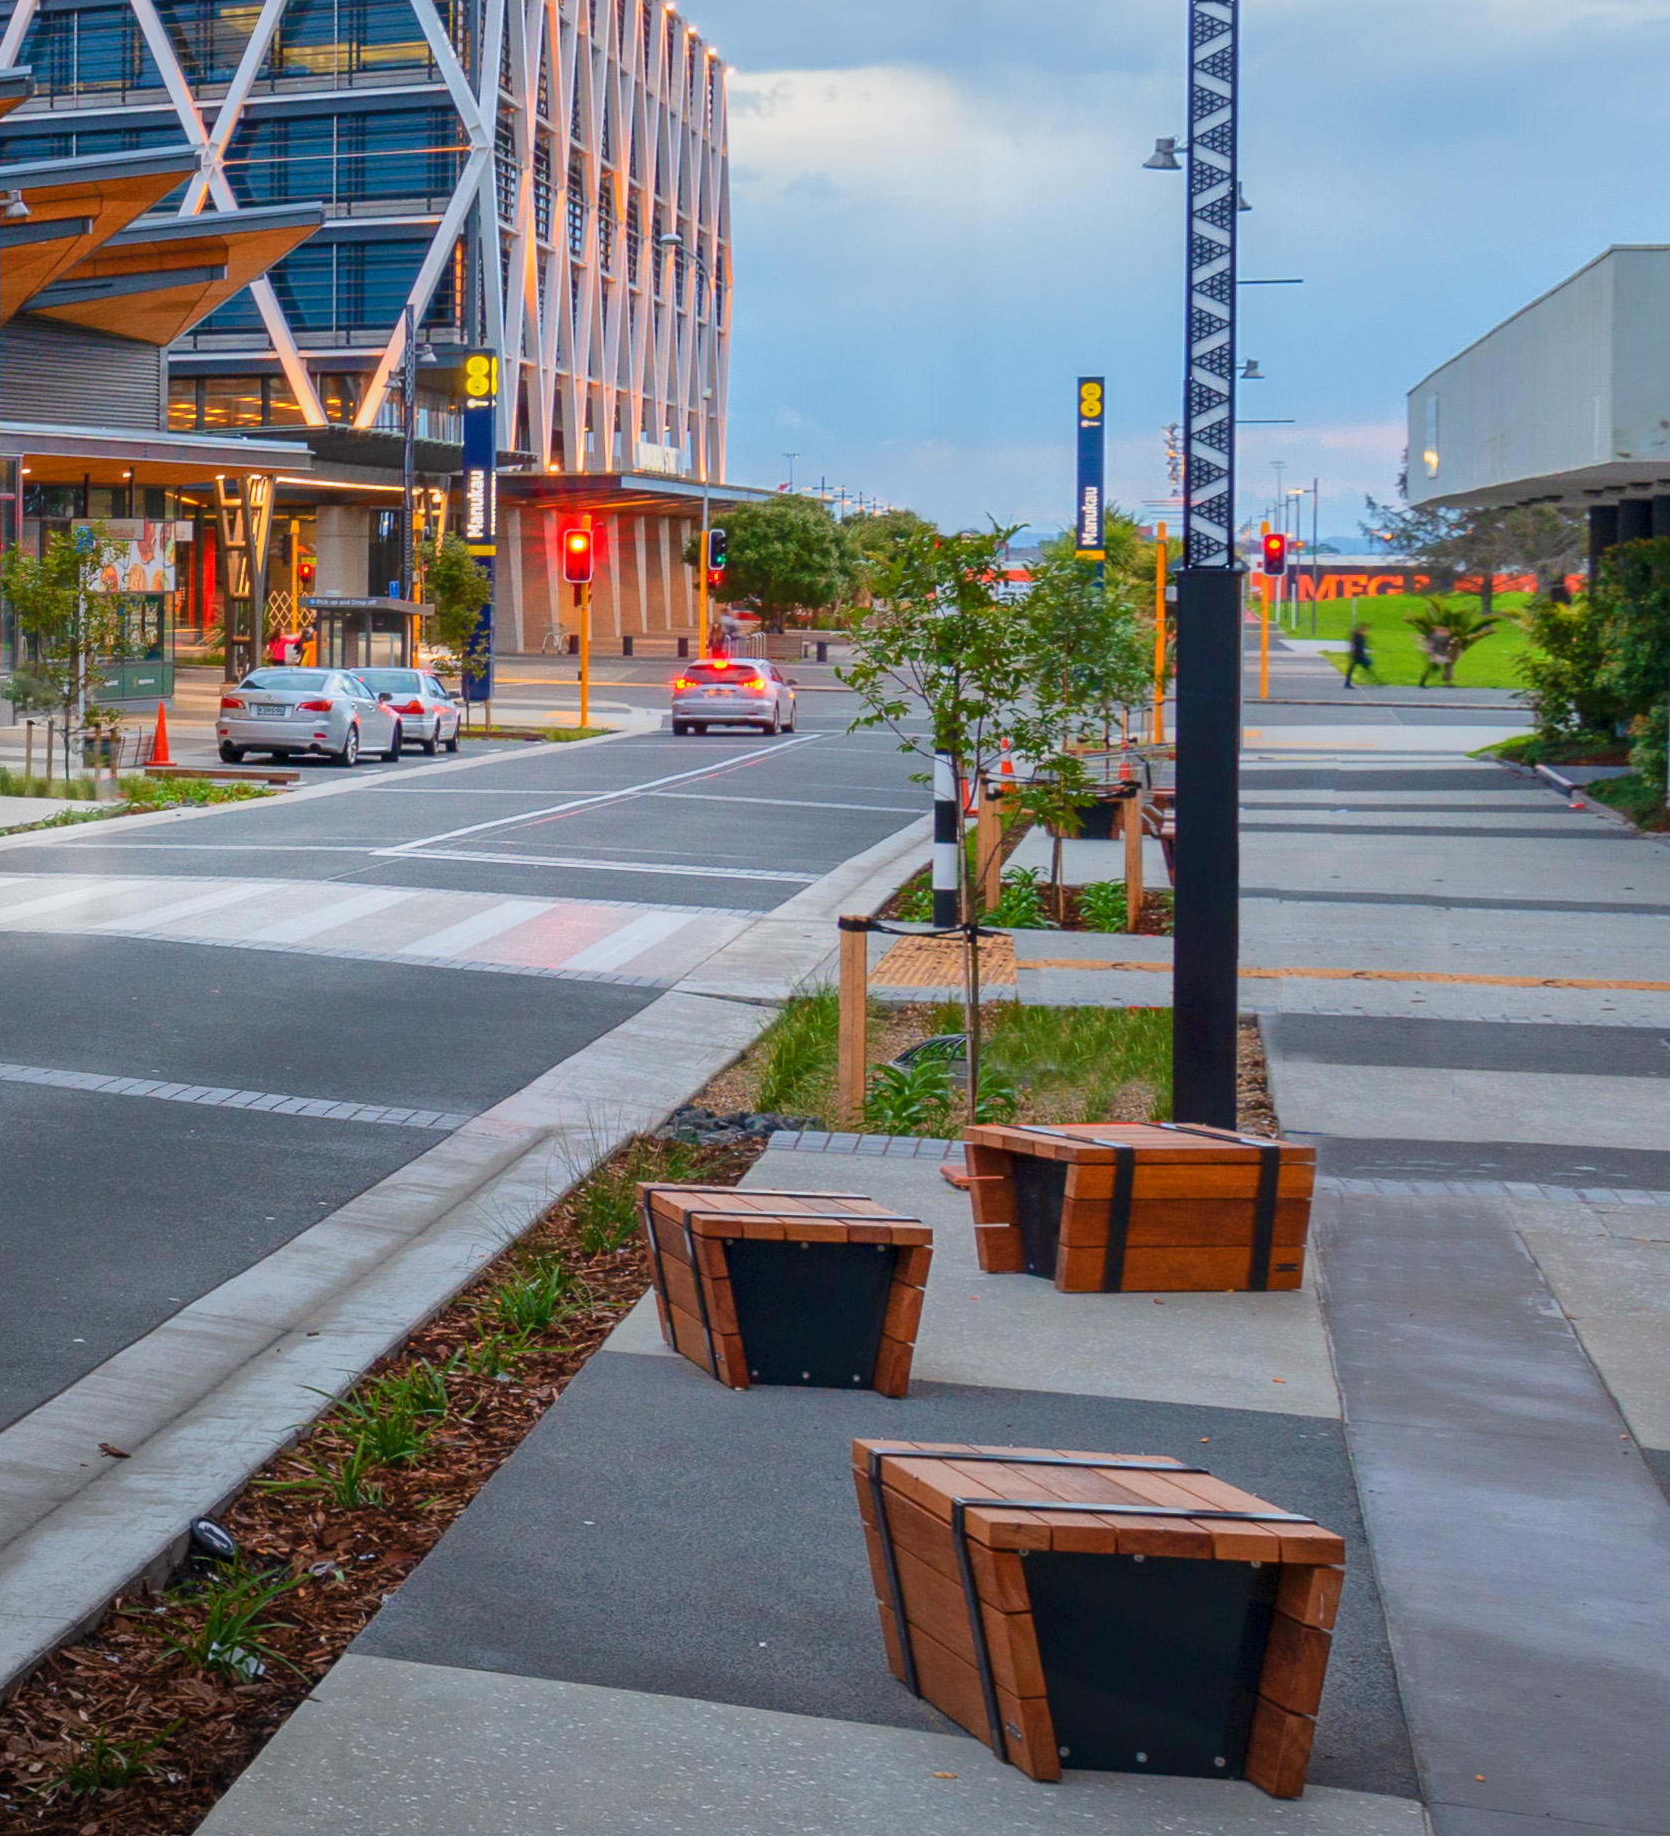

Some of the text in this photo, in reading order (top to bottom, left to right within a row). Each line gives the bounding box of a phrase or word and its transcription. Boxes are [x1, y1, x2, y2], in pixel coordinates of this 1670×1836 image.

[467, 470, 485, 538] Manukau
[1081, 486, 1098, 546] Manukau
[351, 599, 367, 607] Drop
